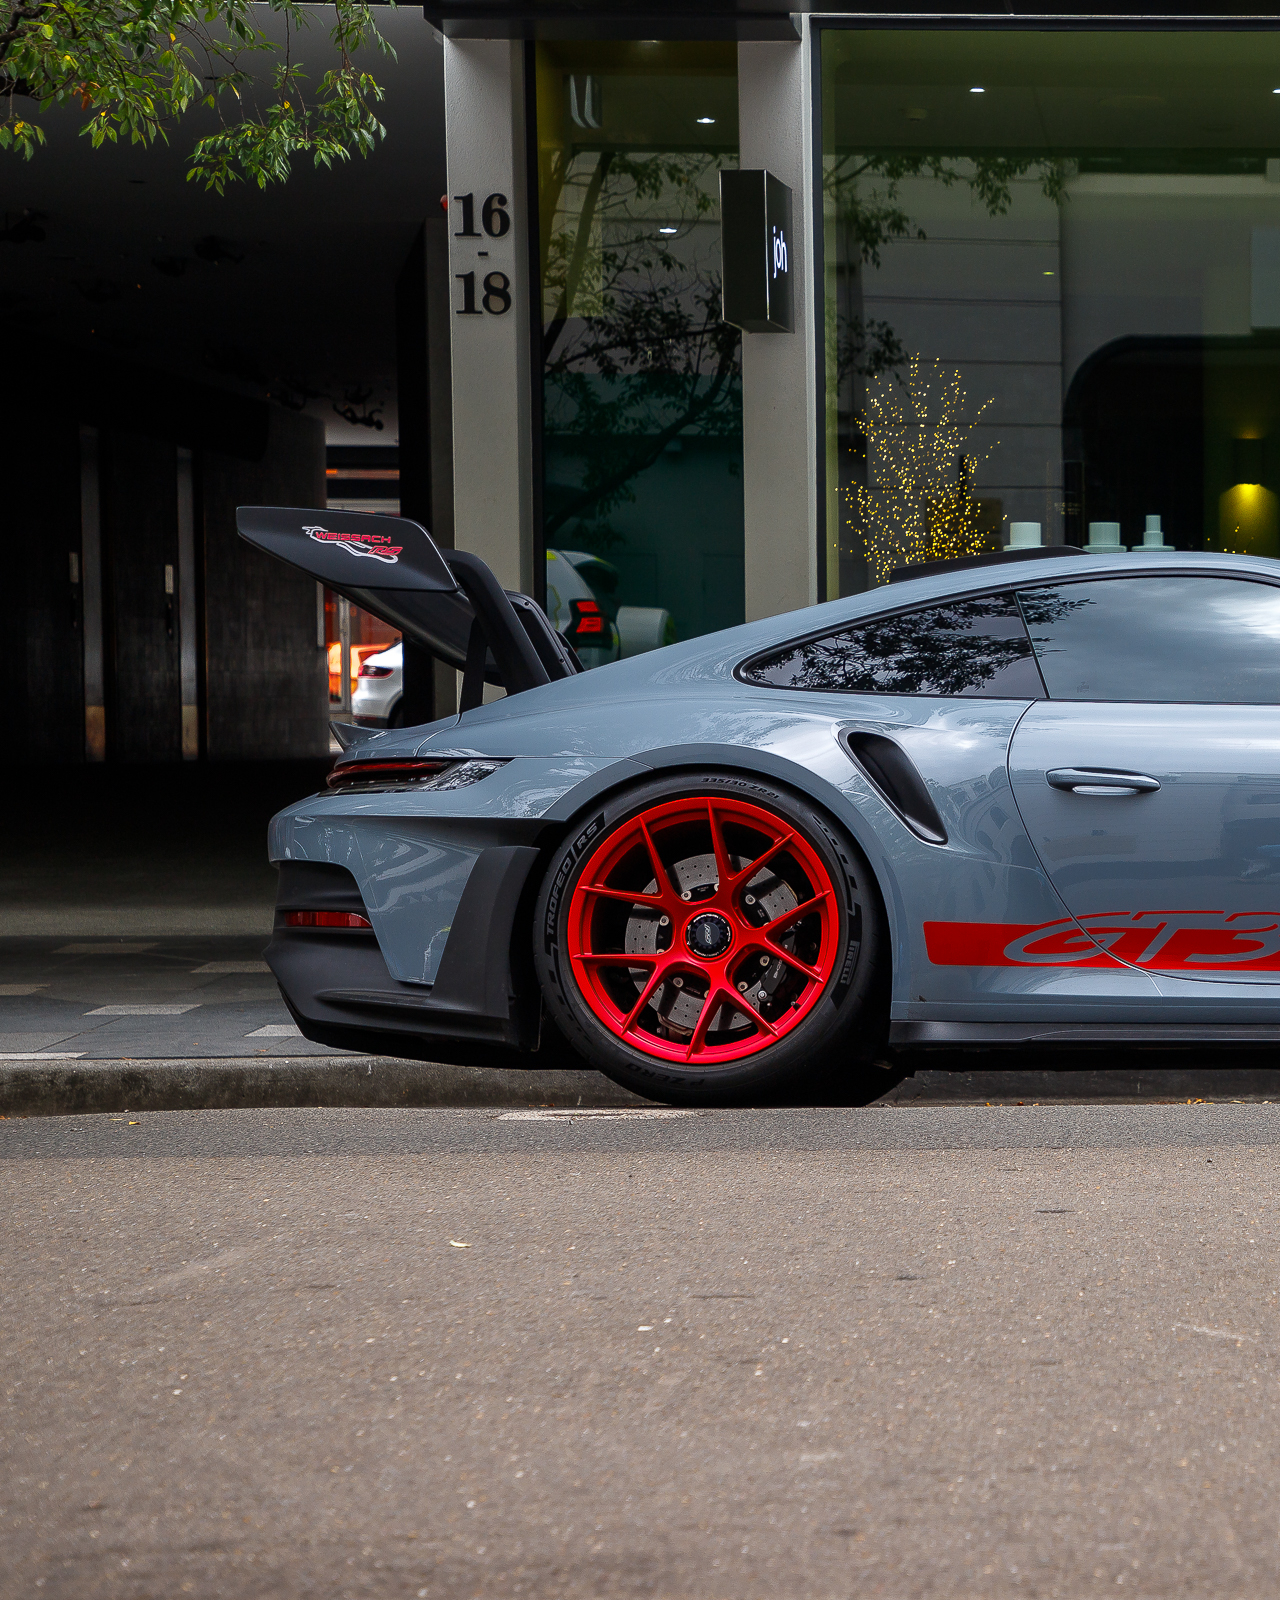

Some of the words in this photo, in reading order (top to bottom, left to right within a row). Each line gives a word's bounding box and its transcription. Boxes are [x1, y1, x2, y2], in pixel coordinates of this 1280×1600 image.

[453, 192, 511, 237] 16
[773, 226, 787, 278] joh
[455, 271, 512, 315] 18
[316, 531, 391, 543] WEISSACH
[576, 822, 598, 850] RS
[840, 940, 860, 985] PIRELLI
